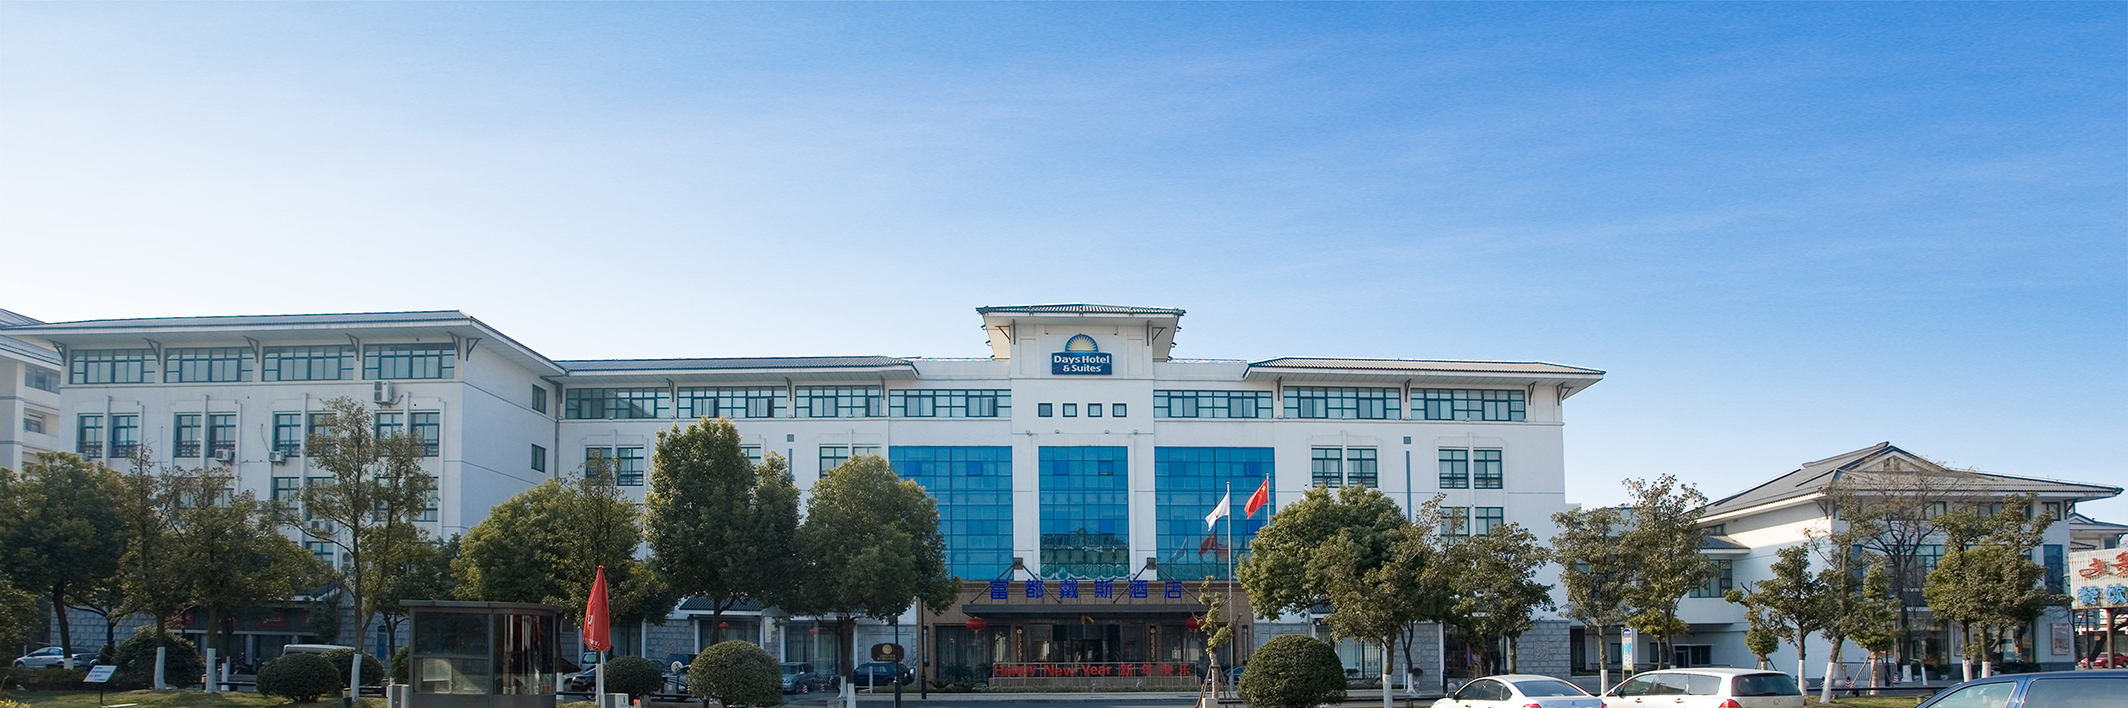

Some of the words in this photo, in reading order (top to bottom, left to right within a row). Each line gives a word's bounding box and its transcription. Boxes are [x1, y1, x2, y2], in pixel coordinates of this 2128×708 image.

[1053, 355, 1081, 364] Days
[1081, 355, 1110, 364] Hotel
[1062, 364, 1070, 372] &
[1071, 364, 1102, 372] Suites
[989, 579, 1183, 599] 富都戴斯酒店
[994, 664, 1037, 677] Happy
[1043, 664, 1076, 677] New
[1082, 664, 1112, 676] Year
